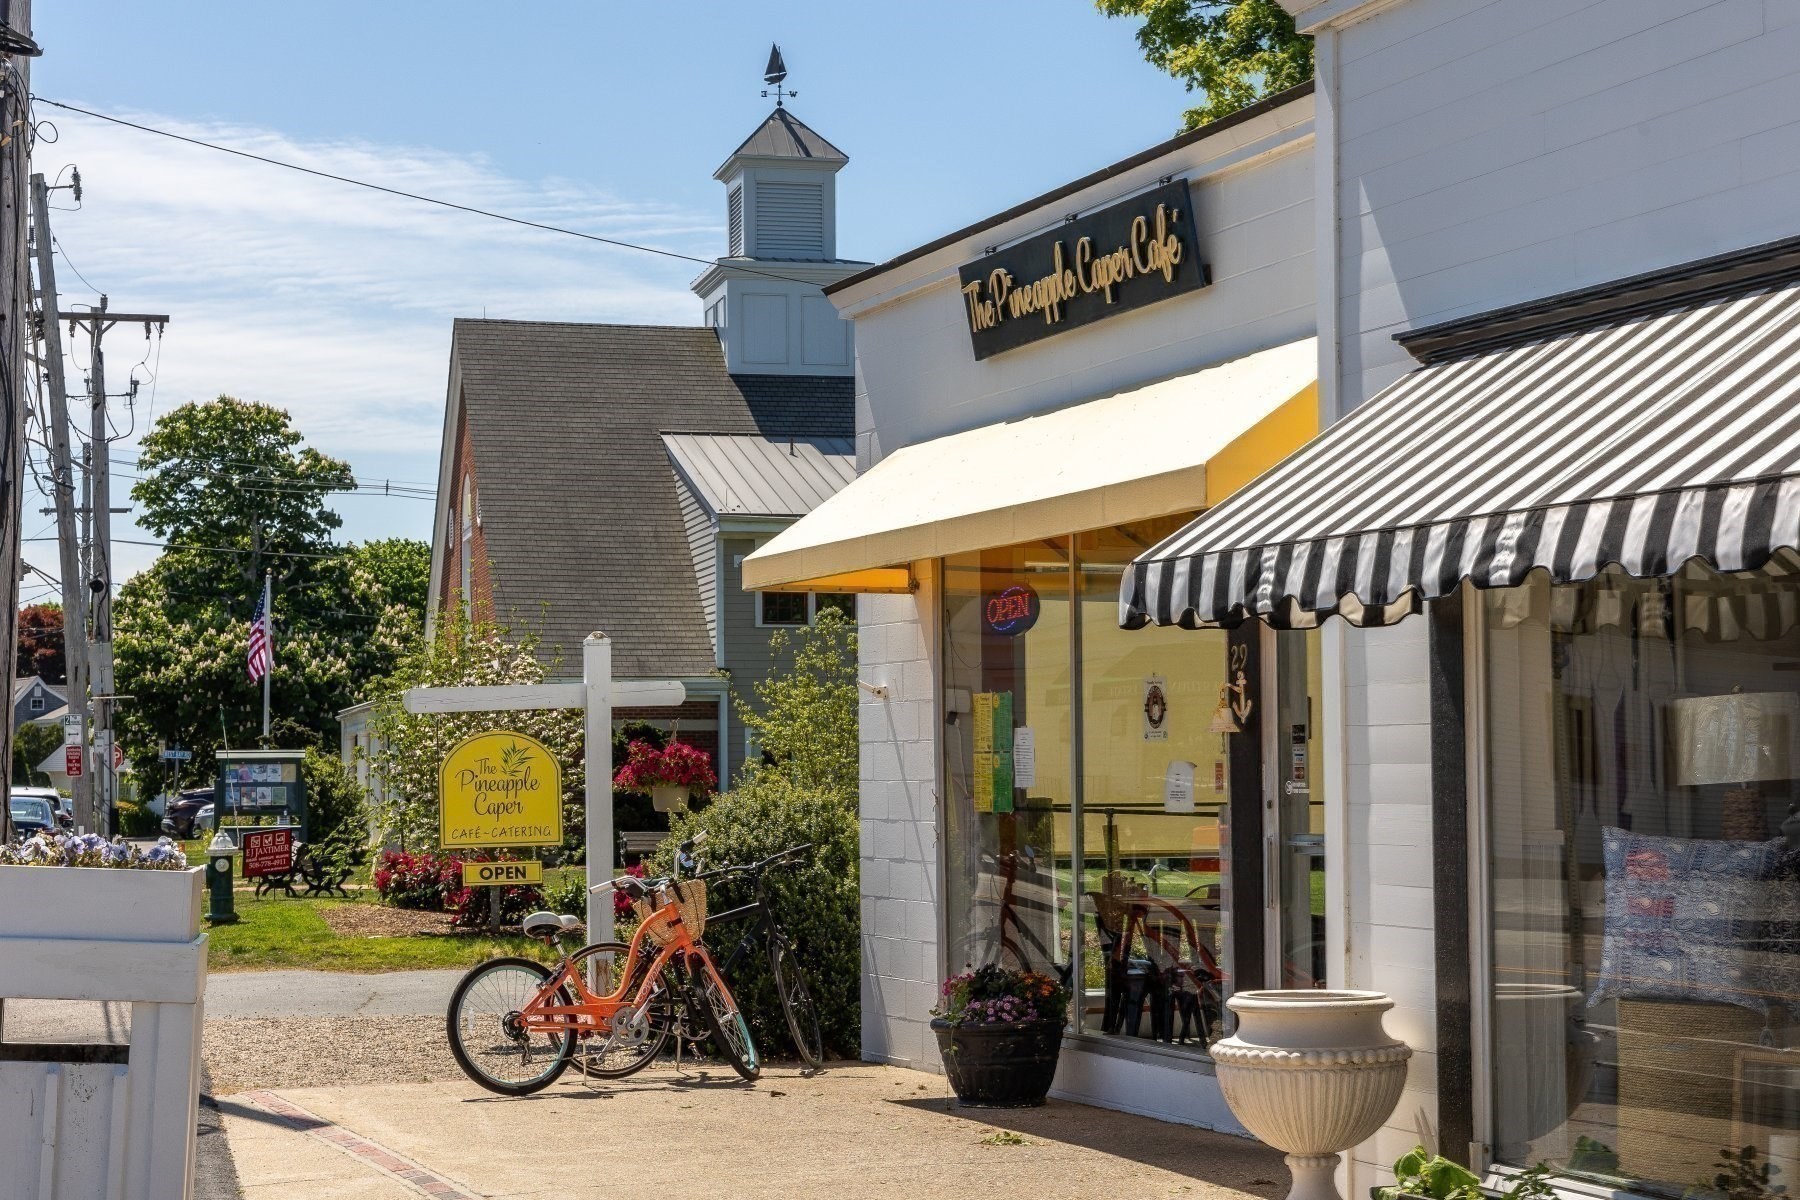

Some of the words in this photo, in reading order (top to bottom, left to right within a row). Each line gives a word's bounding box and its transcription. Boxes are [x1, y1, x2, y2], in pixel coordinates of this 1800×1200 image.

[961, 280, 995, 333] The
[988, 240, 1077, 325] Pineapple
[1076, 236, 1134, 304] Caper
[1131, 203, 1183, 283] Café
[986, 593, 1030, 623] OPEN
[1230, 643, 1248, 671] 29
[474, 757, 498, 775] The
[454, 765, 541, 800] Pineapple
[474, 791, 524, 823] Caper
[491, 825, 552, 838] CATERING
[255, 844, 290, 858] JAXTIMER
[479, 865, 527, 881] OPEN
